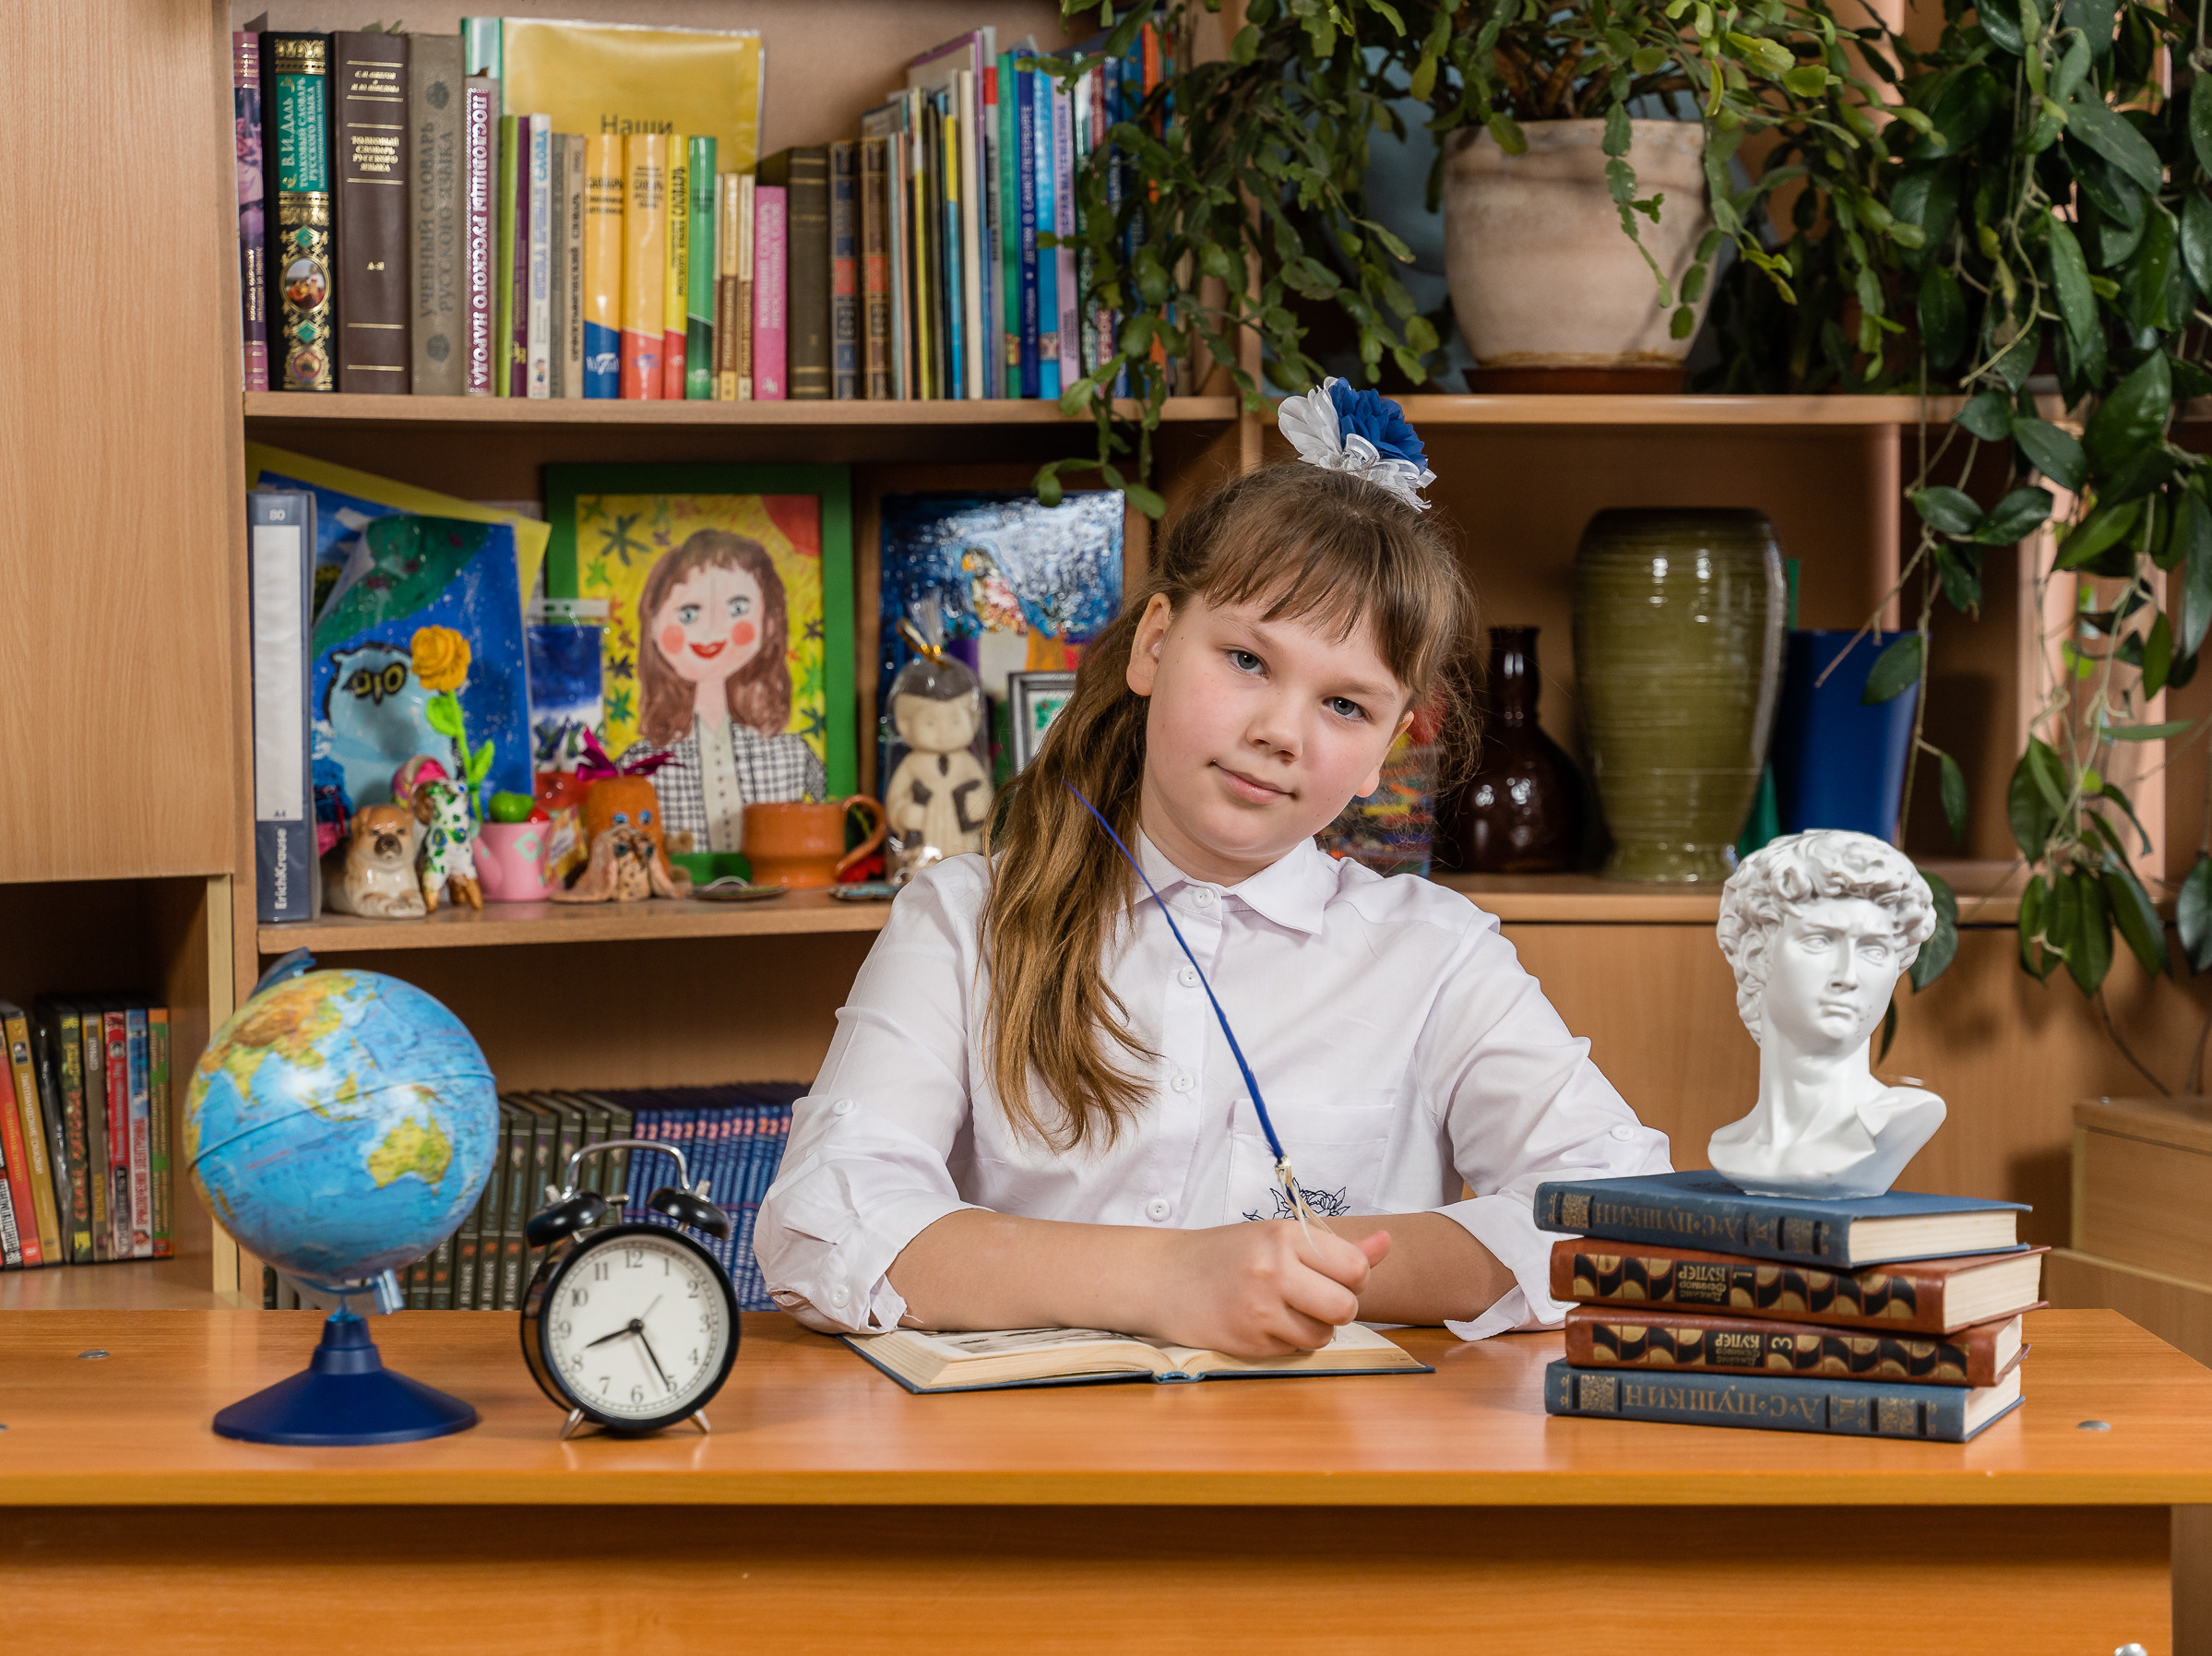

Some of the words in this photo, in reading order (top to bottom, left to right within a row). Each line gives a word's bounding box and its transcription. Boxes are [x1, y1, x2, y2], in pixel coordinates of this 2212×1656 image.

[296, 77, 307, 126] СЛОВАРЬ
[306, 86, 317, 124] ЯЗЫКА
[296, 127, 309, 188] ТОЛКОВЫЙ
[307, 124, 319, 182] РУССКОГО
[352, 153, 398, 164] РУССКОГО
[470, 94, 489, 212] ПОСЛОВИЦЫ
[531, 129, 549, 182] СЛОВА
[420, 122, 435, 213] СЛОВАРЬ
[438, 131, 454, 198] ЯЗЫКА
[671, 166, 686, 217] СЛОВАРЬ
[1023, 226, 1036, 265] ДЕТЯМ
[438, 208, 457, 312] РУССКОГО
[470, 214, 489, 309] РУССКОГО
[470, 311, 489, 386] НАРОДА
[624, 1250, 644, 1269] 12
[662, 1257, 671, 1277] 1
[594, 1262, 609, 1281] 11
[1678, 1265, 1726, 1282] КУПЕР
[686, 1281, 699, 1299] 2
[1679, 1281, 1727, 1293] Фенимор
[571, 1288, 589, 1307] 10
[558, 1321, 572, 1340] 9
[699, 1314, 711, 1333] 3
[1714, 1332, 1760, 1349] КУПЕР
[1771, 1336, 1793, 1351] 3
[570, 1353, 584, 1373] 8
[687, 1348, 699, 1365] 4
[600, 1376, 612, 1395] 7
[666, 1374, 678, 1393] 5
[631, 1386, 644, 1404] 6
